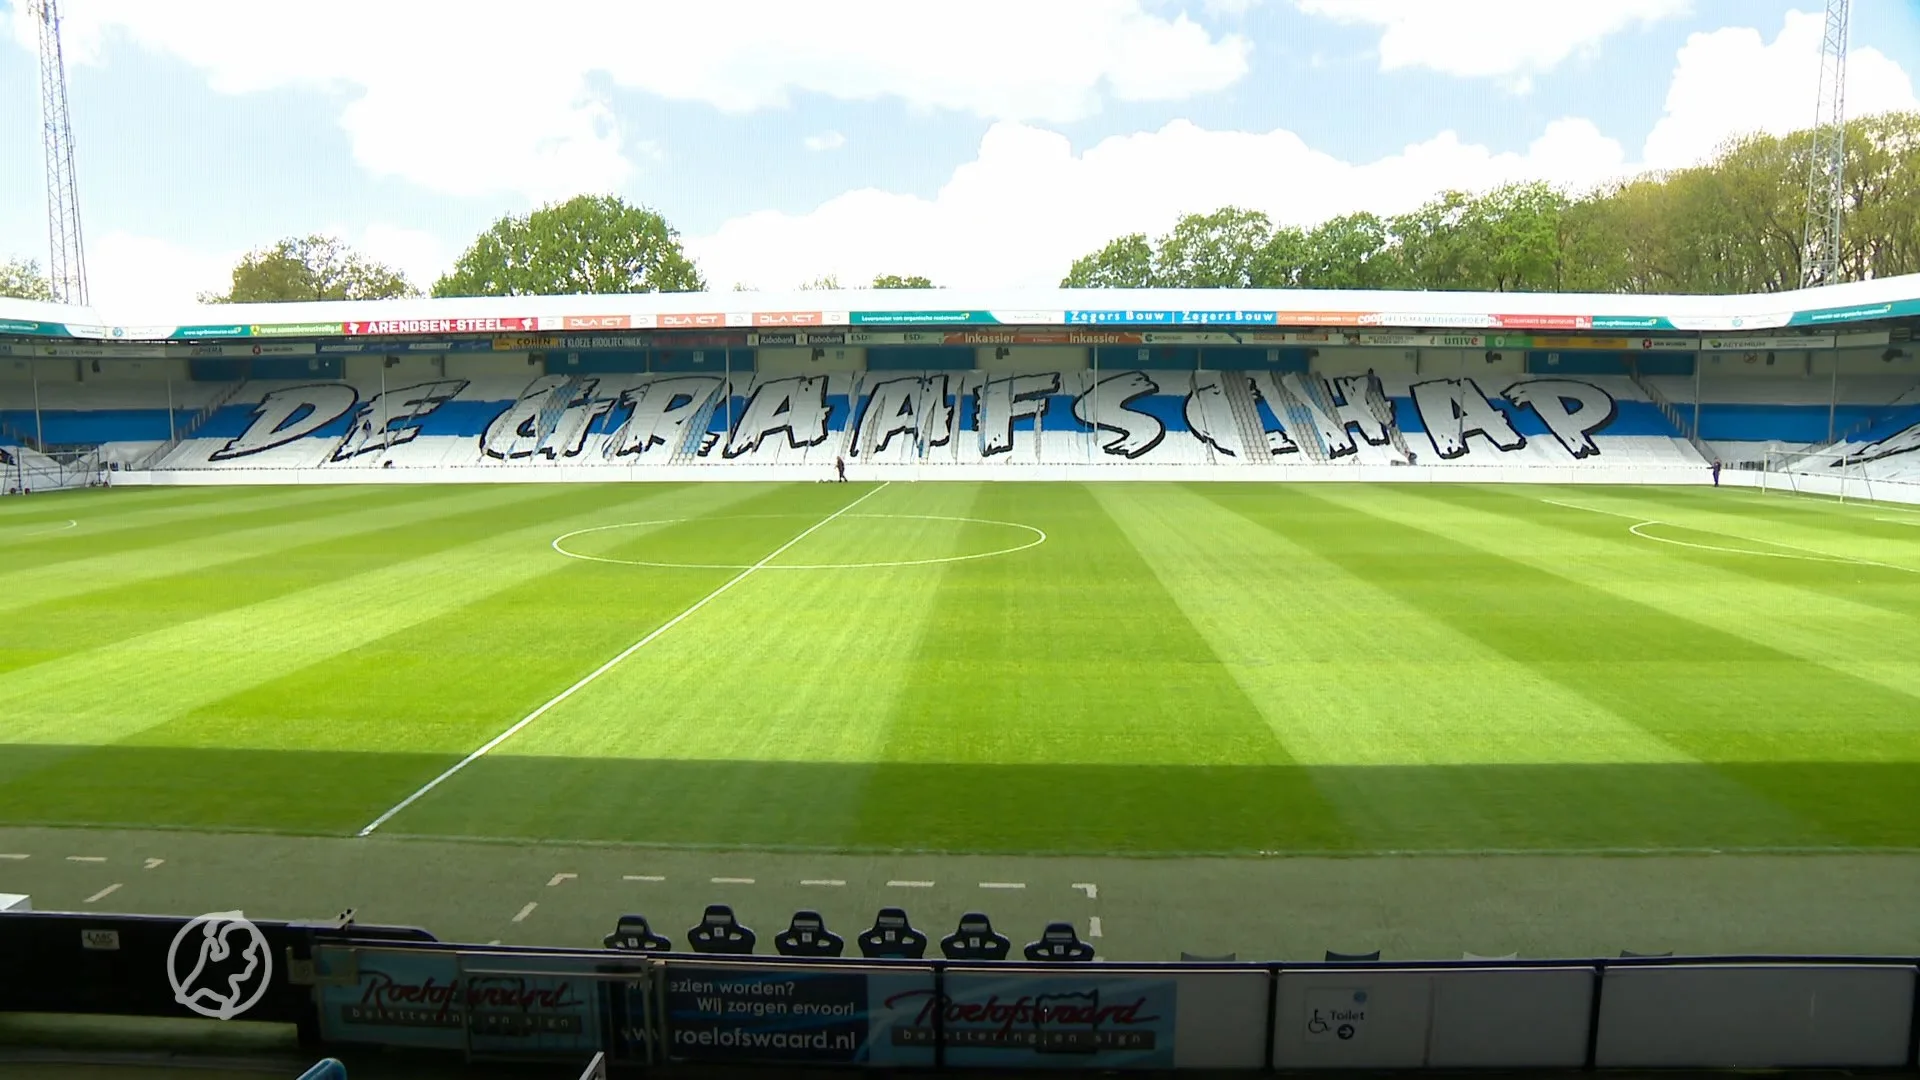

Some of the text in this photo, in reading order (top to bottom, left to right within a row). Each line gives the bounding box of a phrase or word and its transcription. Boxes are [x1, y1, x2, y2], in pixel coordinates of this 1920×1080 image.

[1071, 311, 1164, 324] Zegers Bouw
[1182, 311, 1231, 324] Zegers
[1235, 311, 1273, 321] Bouw
[760, 335, 795, 344] Rabobank
[809, 335, 843, 344] Rabobank
[965, 332, 1015, 343] Inkassier
[1070, 332, 1119, 343] Inkassier
[669, 979, 714, 993] ezien
[720, 980, 795, 995] worden?
[697, 997, 723, 1014] Wij
[727, 1001, 787, 1016] zorgen
[1331, 1010, 1364, 1021] Toilet
